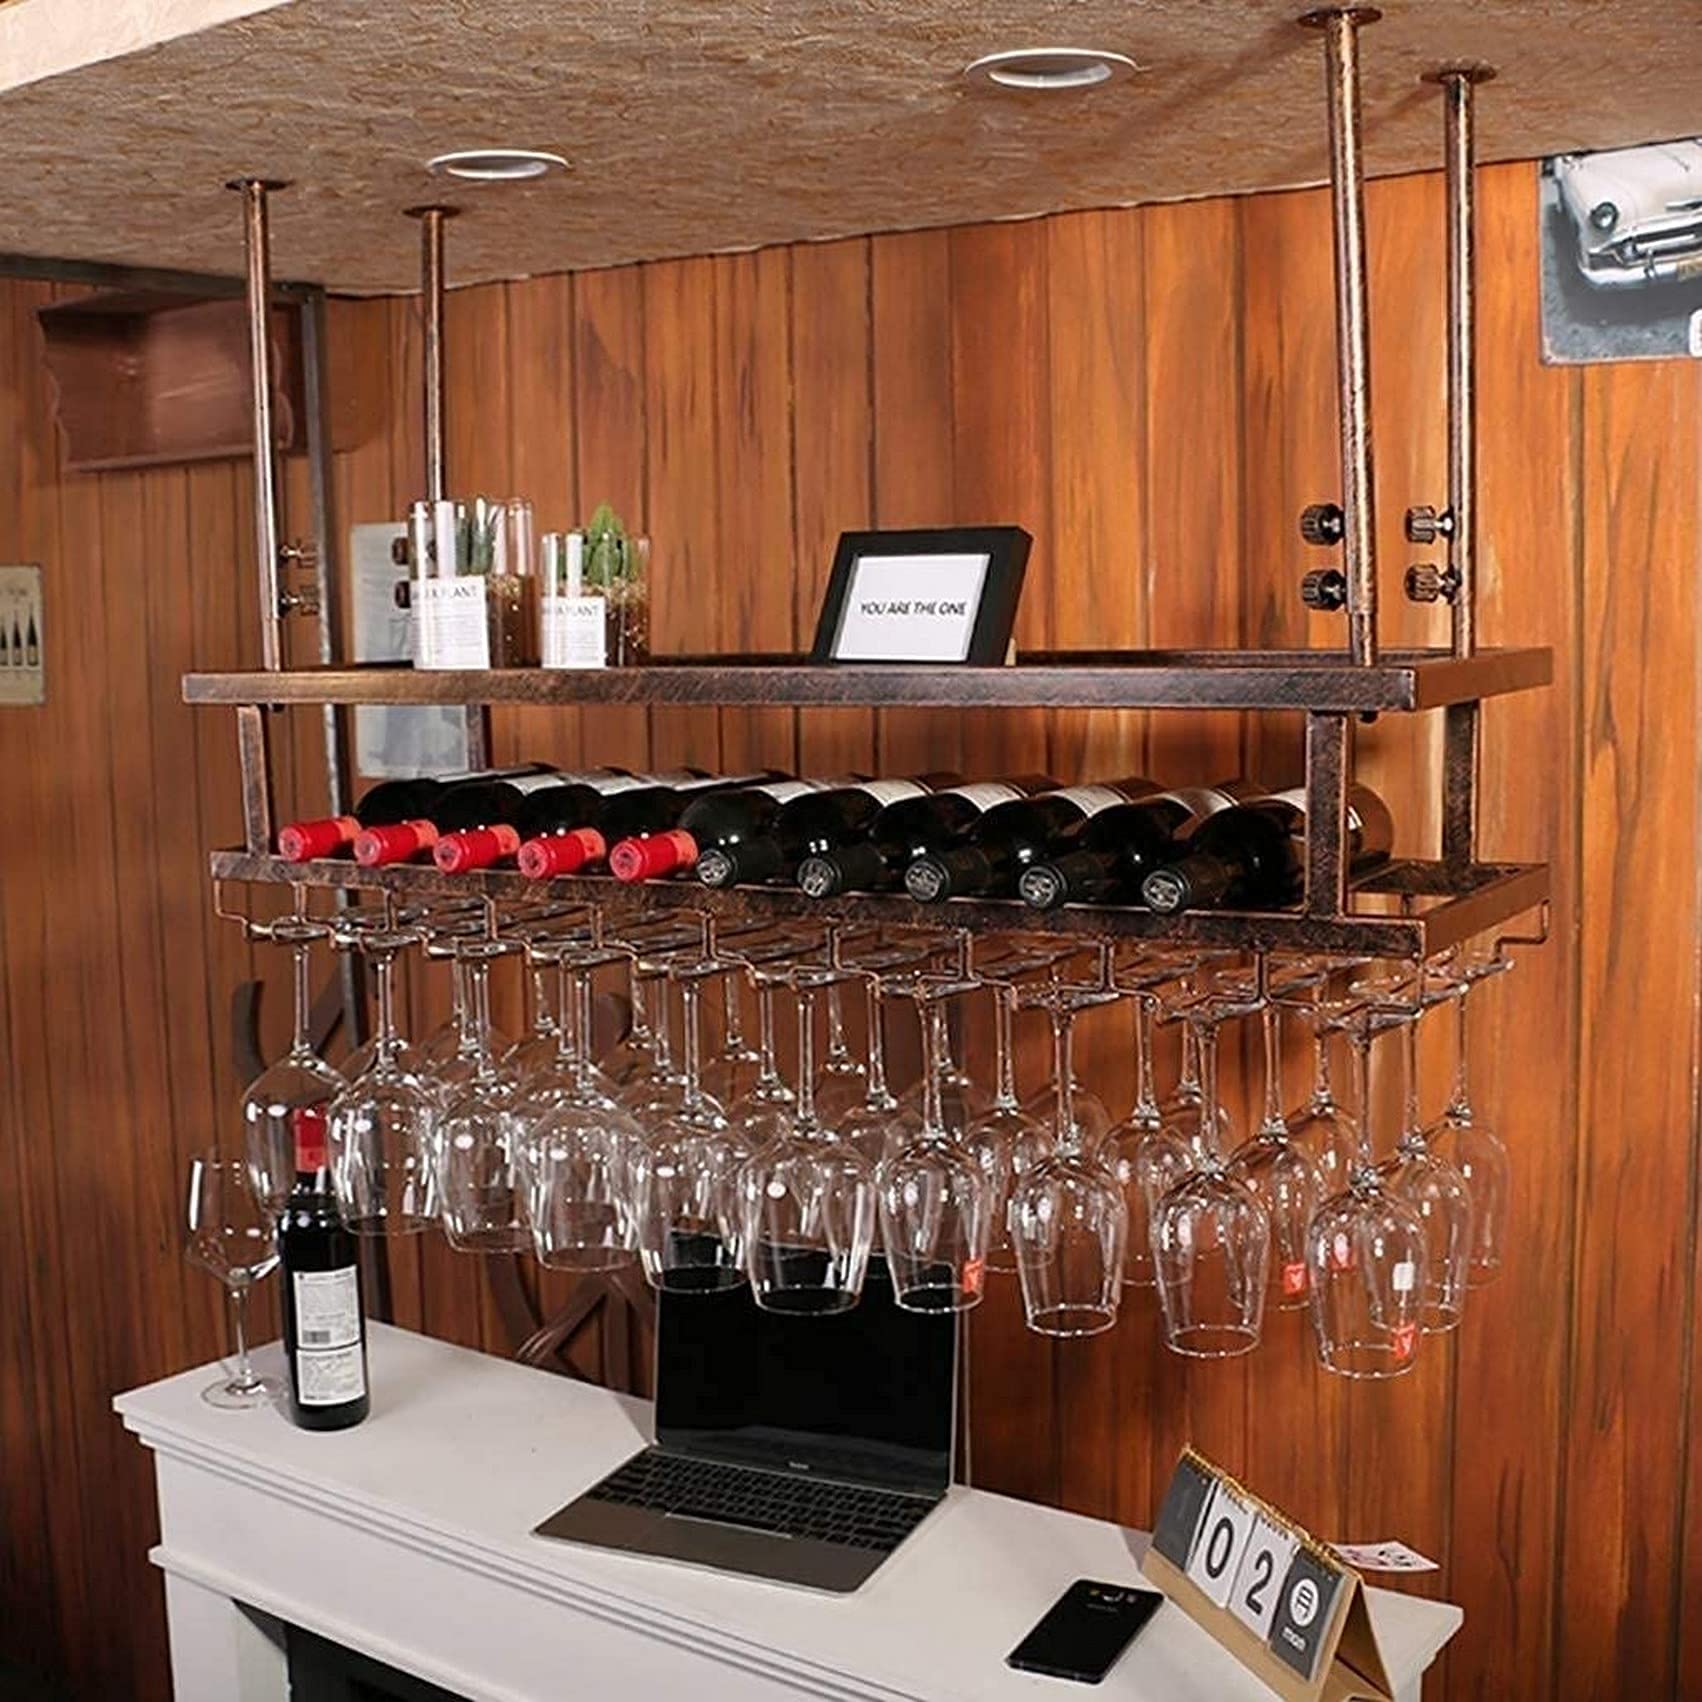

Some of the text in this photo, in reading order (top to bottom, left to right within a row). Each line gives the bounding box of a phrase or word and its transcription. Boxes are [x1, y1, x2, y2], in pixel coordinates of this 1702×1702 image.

[861, 601, 967, 615] YOU ARE THE ONE
[1205, 1516, 1274, 1616] 0 2
